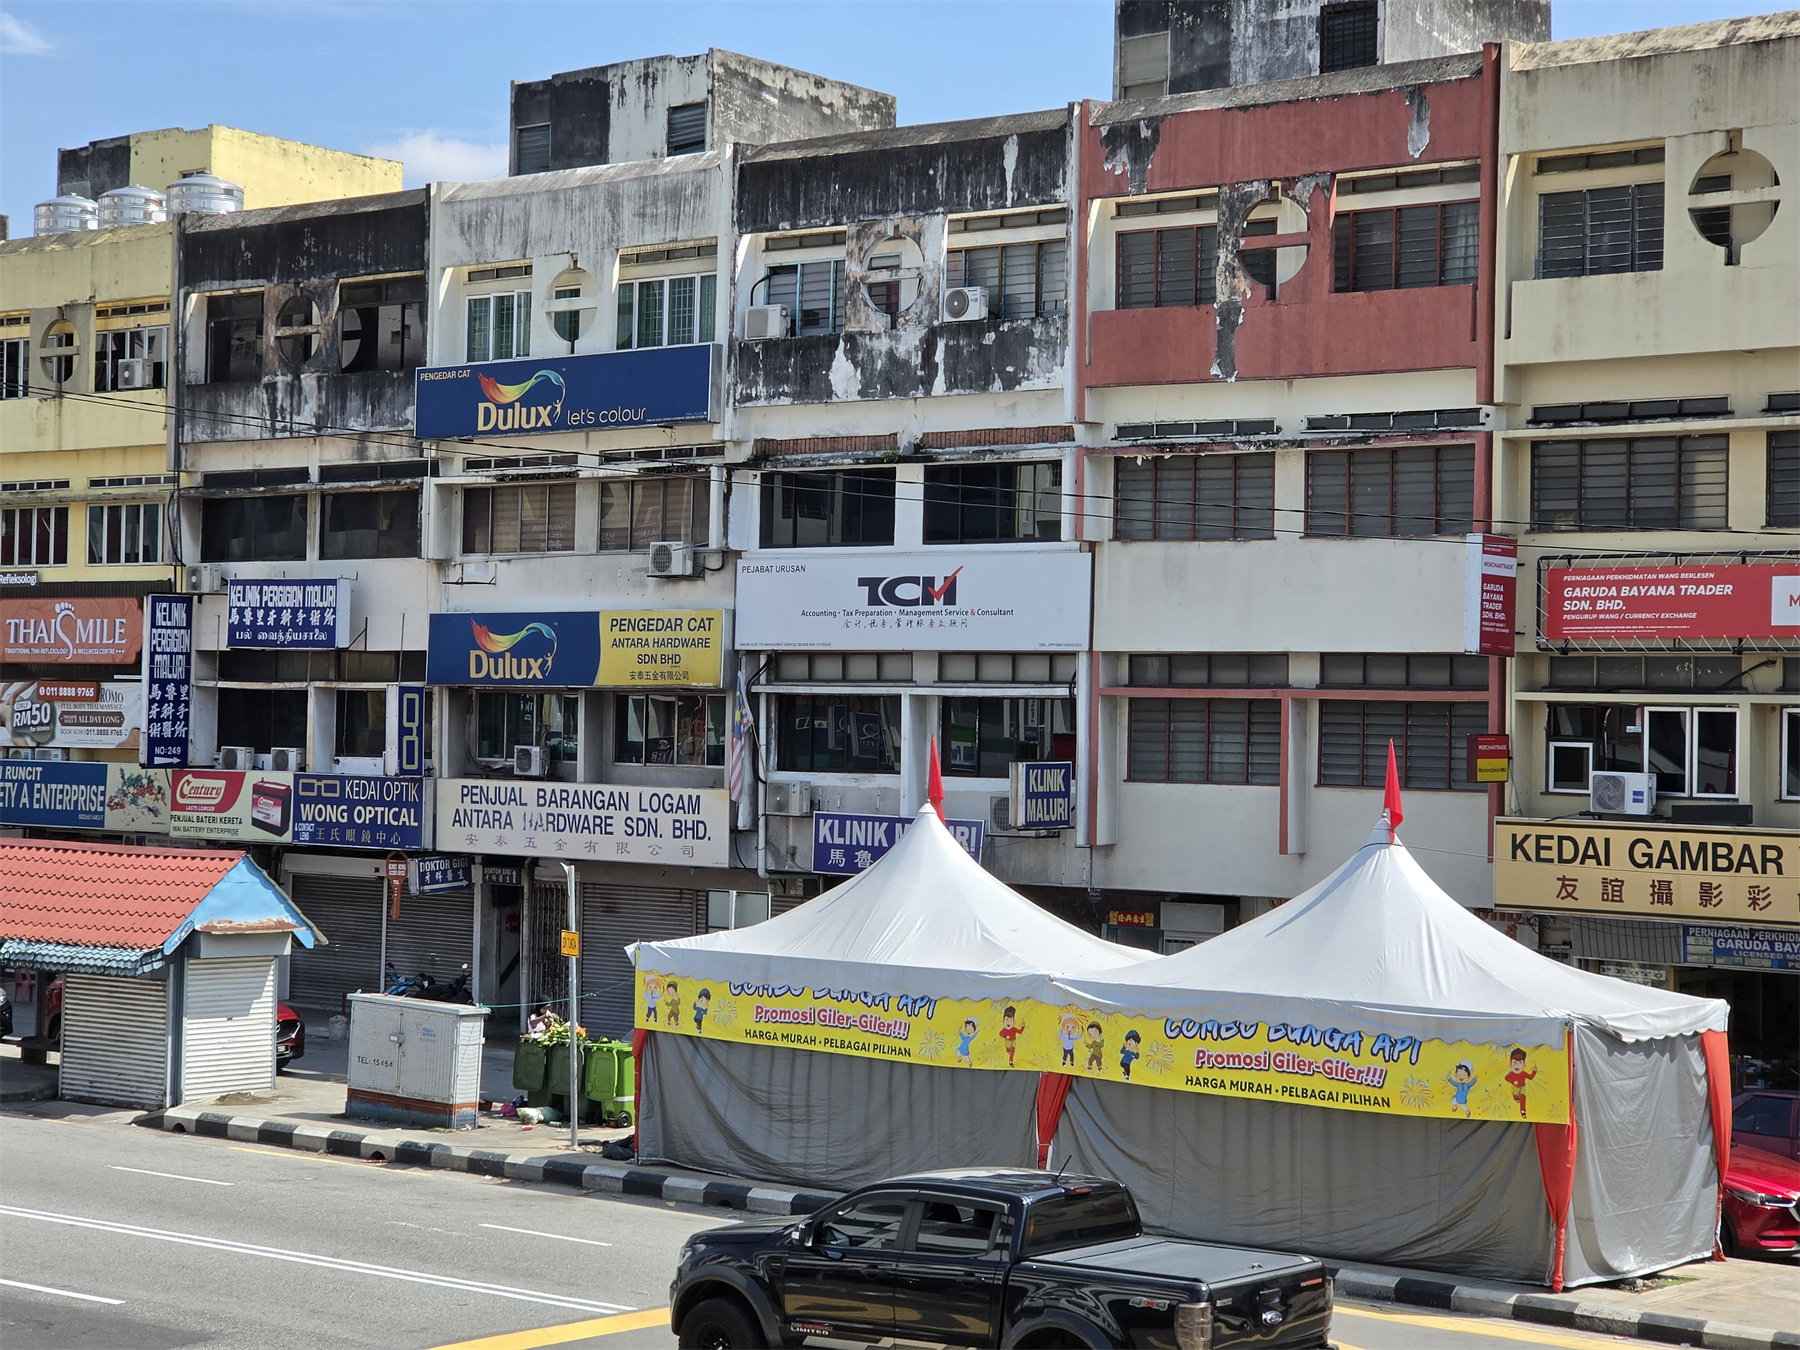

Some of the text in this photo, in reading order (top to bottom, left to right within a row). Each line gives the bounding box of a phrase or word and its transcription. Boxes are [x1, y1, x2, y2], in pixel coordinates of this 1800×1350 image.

[420, 369, 470, 381] PENGEDAR CAT
[477, 402, 552, 432] Dulux
[567, 406, 646, 426] let's colour
[742, 564, 806, 573] PEJABAT URUSAN
[230, 585, 336, 607] KELINIK PERGIGIAN MALURI
[1482, 593, 1503, 601] BAYANA
[1483, 583, 1504, 592] GARUDA
[1564, 584, 1733, 597] GARUDA BAYANA TRADER
[156, 602, 186, 626] KELINIK
[801, 609, 837, 618] Accounting
[854, 609, 892, 618] Preparation
[899, 609, 943, 618] Management
[1483, 602, 1502, 610] TRADER
[1563, 600, 1626, 610] SDN. BHD.
[610, 617, 714, 632] PENGEDAR CAT
[152, 629, 190, 652] PERGIGIAN
[611, 638, 711, 648] ANTARA HARDWARE
[154, 655, 185, 679] MALURI
[469, 650, 544, 679] Dulux
[637, 654, 681, 664] SDN BHD
[630, 671, 689, 681] 安泰五金有限公司
[46, 687, 94, 696] 011 8888 9765
[101, 688, 124, 702] ROMO
[13, 703, 51, 727] RM50
[89, 716, 102, 724] DAY
[103, 716, 120, 724] LONG
[5, 767, 42, 780] RUNCIT
[1029, 768, 1066, 793] KLINIK
[20, 783, 30, 808] A
[33, 784, 105, 812] ENTERPRISE
[180, 779, 222, 799] Century
[346, 780, 419, 802] KEDAI OPTIK
[461, 784, 701, 815] PENJUAL BARANGAN LOGAM
[170, 814, 242, 825] PENJUAL BATERI KERETA
[300, 804, 418, 826] WONG OPTICAL
[1026, 798, 1068, 822] MALURI
[452, 808, 711, 841] ANTARA HARDWARE SDN. BHD.
[818, 818, 977, 852] KLINIK MRI
[316, 828, 401, 845] 王氏眼鏡中心
[465, 833, 694, 858] 安泰五金有限公司
[420, 860, 450, 872] DOKTOR
[453, 857, 468, 868] GIGI
[1511, 833, 1610, 867] KEDAI
[1628, 838, 1784, 875] GAMBAR
[1556, 875, 1800, 911] 友誼攝影彩
[1689, 927, 1750, 939] PERNIAGAAN
[1716, 939, 1771, 951] GARUDA
[1733, 950, 1783, 959] LICENSED
[897, 995, 937, 1019] API
[754, 1004, 909, 1039] Promosi Giler-Giler!!!
[745, 1029, 911, 1057] HARGA MURAH PELBAGAI PILIHAN
[1372, 1033, 1422, 1065] API
[1195, 1048, 1386, 1087] Promosi Giler-Giler!!!
[1186, 1076, 1390, 1108] HARGA MURAH PELBAGAI PILIHAN
